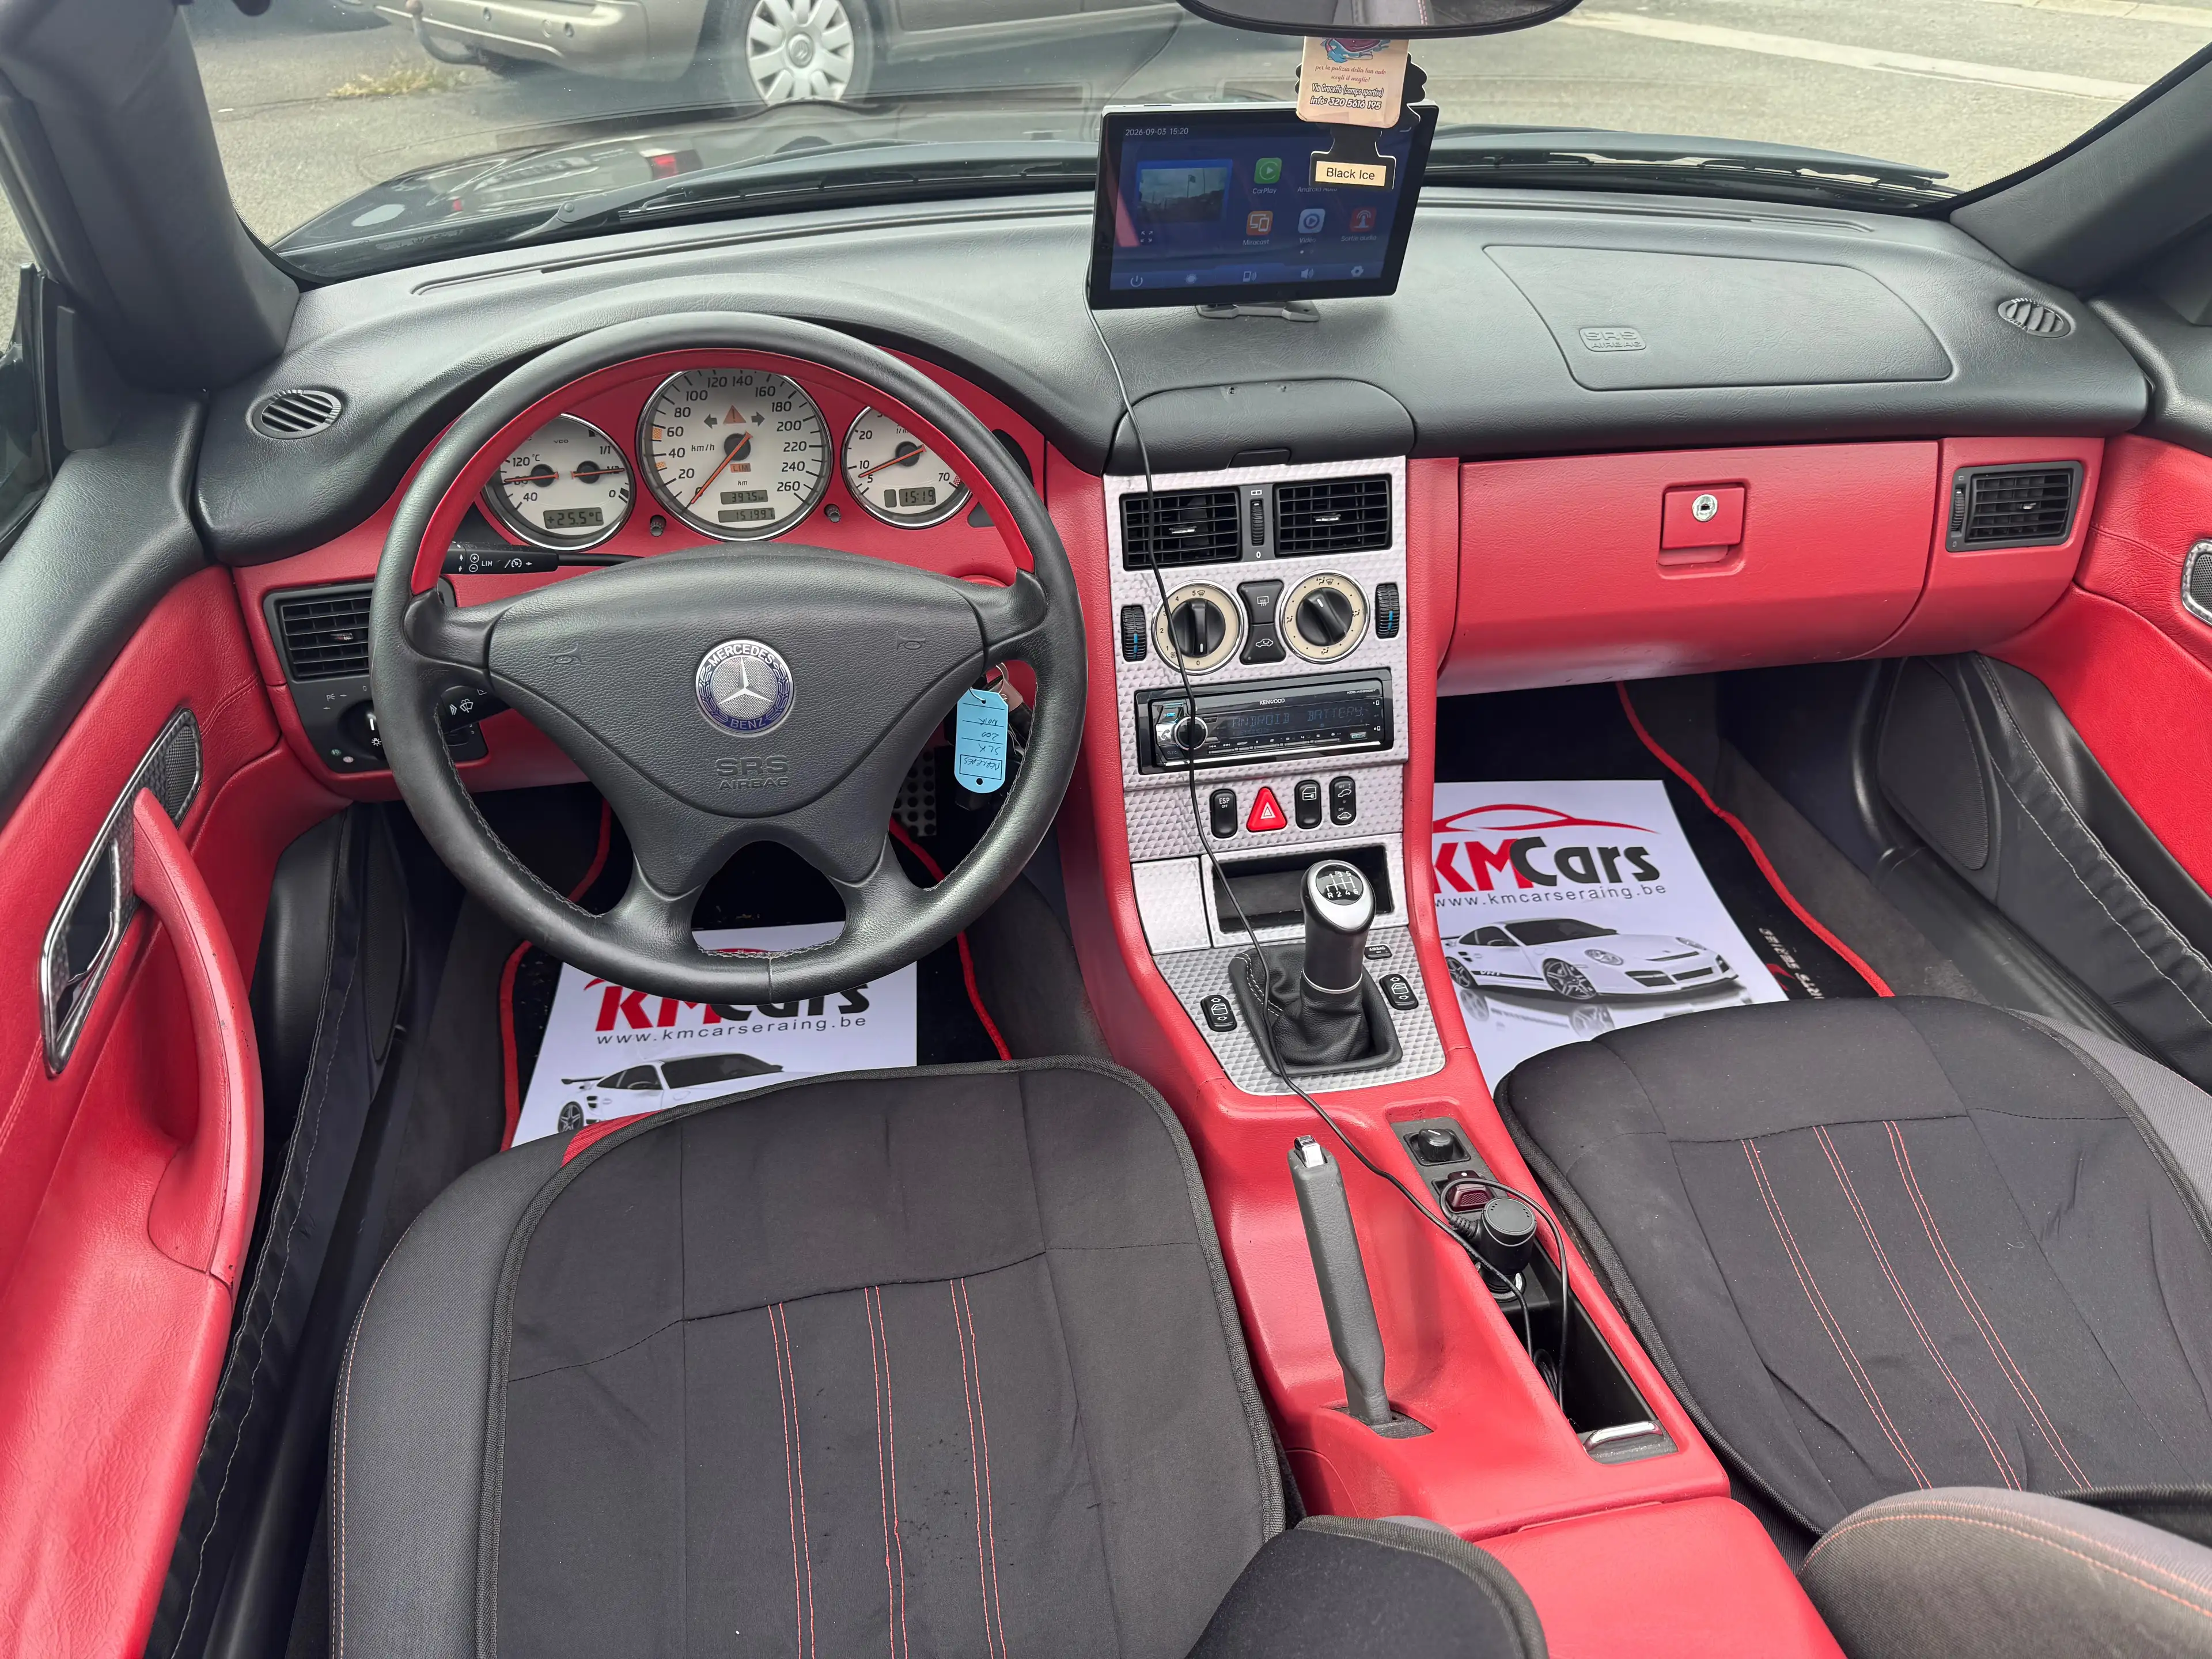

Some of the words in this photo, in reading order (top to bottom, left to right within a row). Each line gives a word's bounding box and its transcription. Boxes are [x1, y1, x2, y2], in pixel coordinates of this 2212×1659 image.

[1312, 83, 1320, 92] Via
[1343, 84, 1362, 96] (campo
[1362, 87, 1384, 98] sportivo)
[1310, 96, 1328, 105] info:
[1328, 97, 1345, 107] 320
[1346, 99, 1365, 108] 5616
[1367, 100, 1382, 110] 195
[1125, 128, 1166, 137] 2026-09-03
[1169, 127, 1189, 135] 15:20
[1326, 167, 1356, 180] Black
[1358, 169, 1375, 181] Ice
[1585, 331, 1637, 340] SRS
[707, 376, 728, 388] 120
[733, 376, 753, 386] 140
[686, 390, 708, 401] 100
[755, 387, 775, 397] 160
[771, 402, 792, 412] 180
[674, 407, 691, 418] 80
[777, 421, 801, 431] 200
[667, 427, 684, 437] 60
[859, 430, 872, 440] 20
[600, 445, 611, 454] 1/1
[691, 444, 715, 452] km/h
[783, 441, 807, 452] 220
[668, 448, 685, 458] 40
[512, 457, 530, 467] 120
[781, 461, 805, 472] 240
[859, 460, 869, 469] 10
[678, 468, 695, 479] 20
[867, 474, 873, 483] 5
[938, 472, 950, 482] 70
[777, 482, 801, 492] 260
[523, 492, 537, 501] 40
[609, 490, 616, 498] 0
[905, 490, 934, 503] 15:19
[736, 509, 773, 520] 151997
[708, 644, 775, 666] MERCEDES
[730, 718, 766, 729] BENZ
[1232, 713, 1290, 728] ANDROID
[982, 732, 999, 741] 200
[715, 755, 789, 776] SRS
[719, 777, 790, 790] AIRBAG
[1432, 836, 1661, 893] KMCars
[597, 1015, 867, 1045] www.kmcarseraing.be
